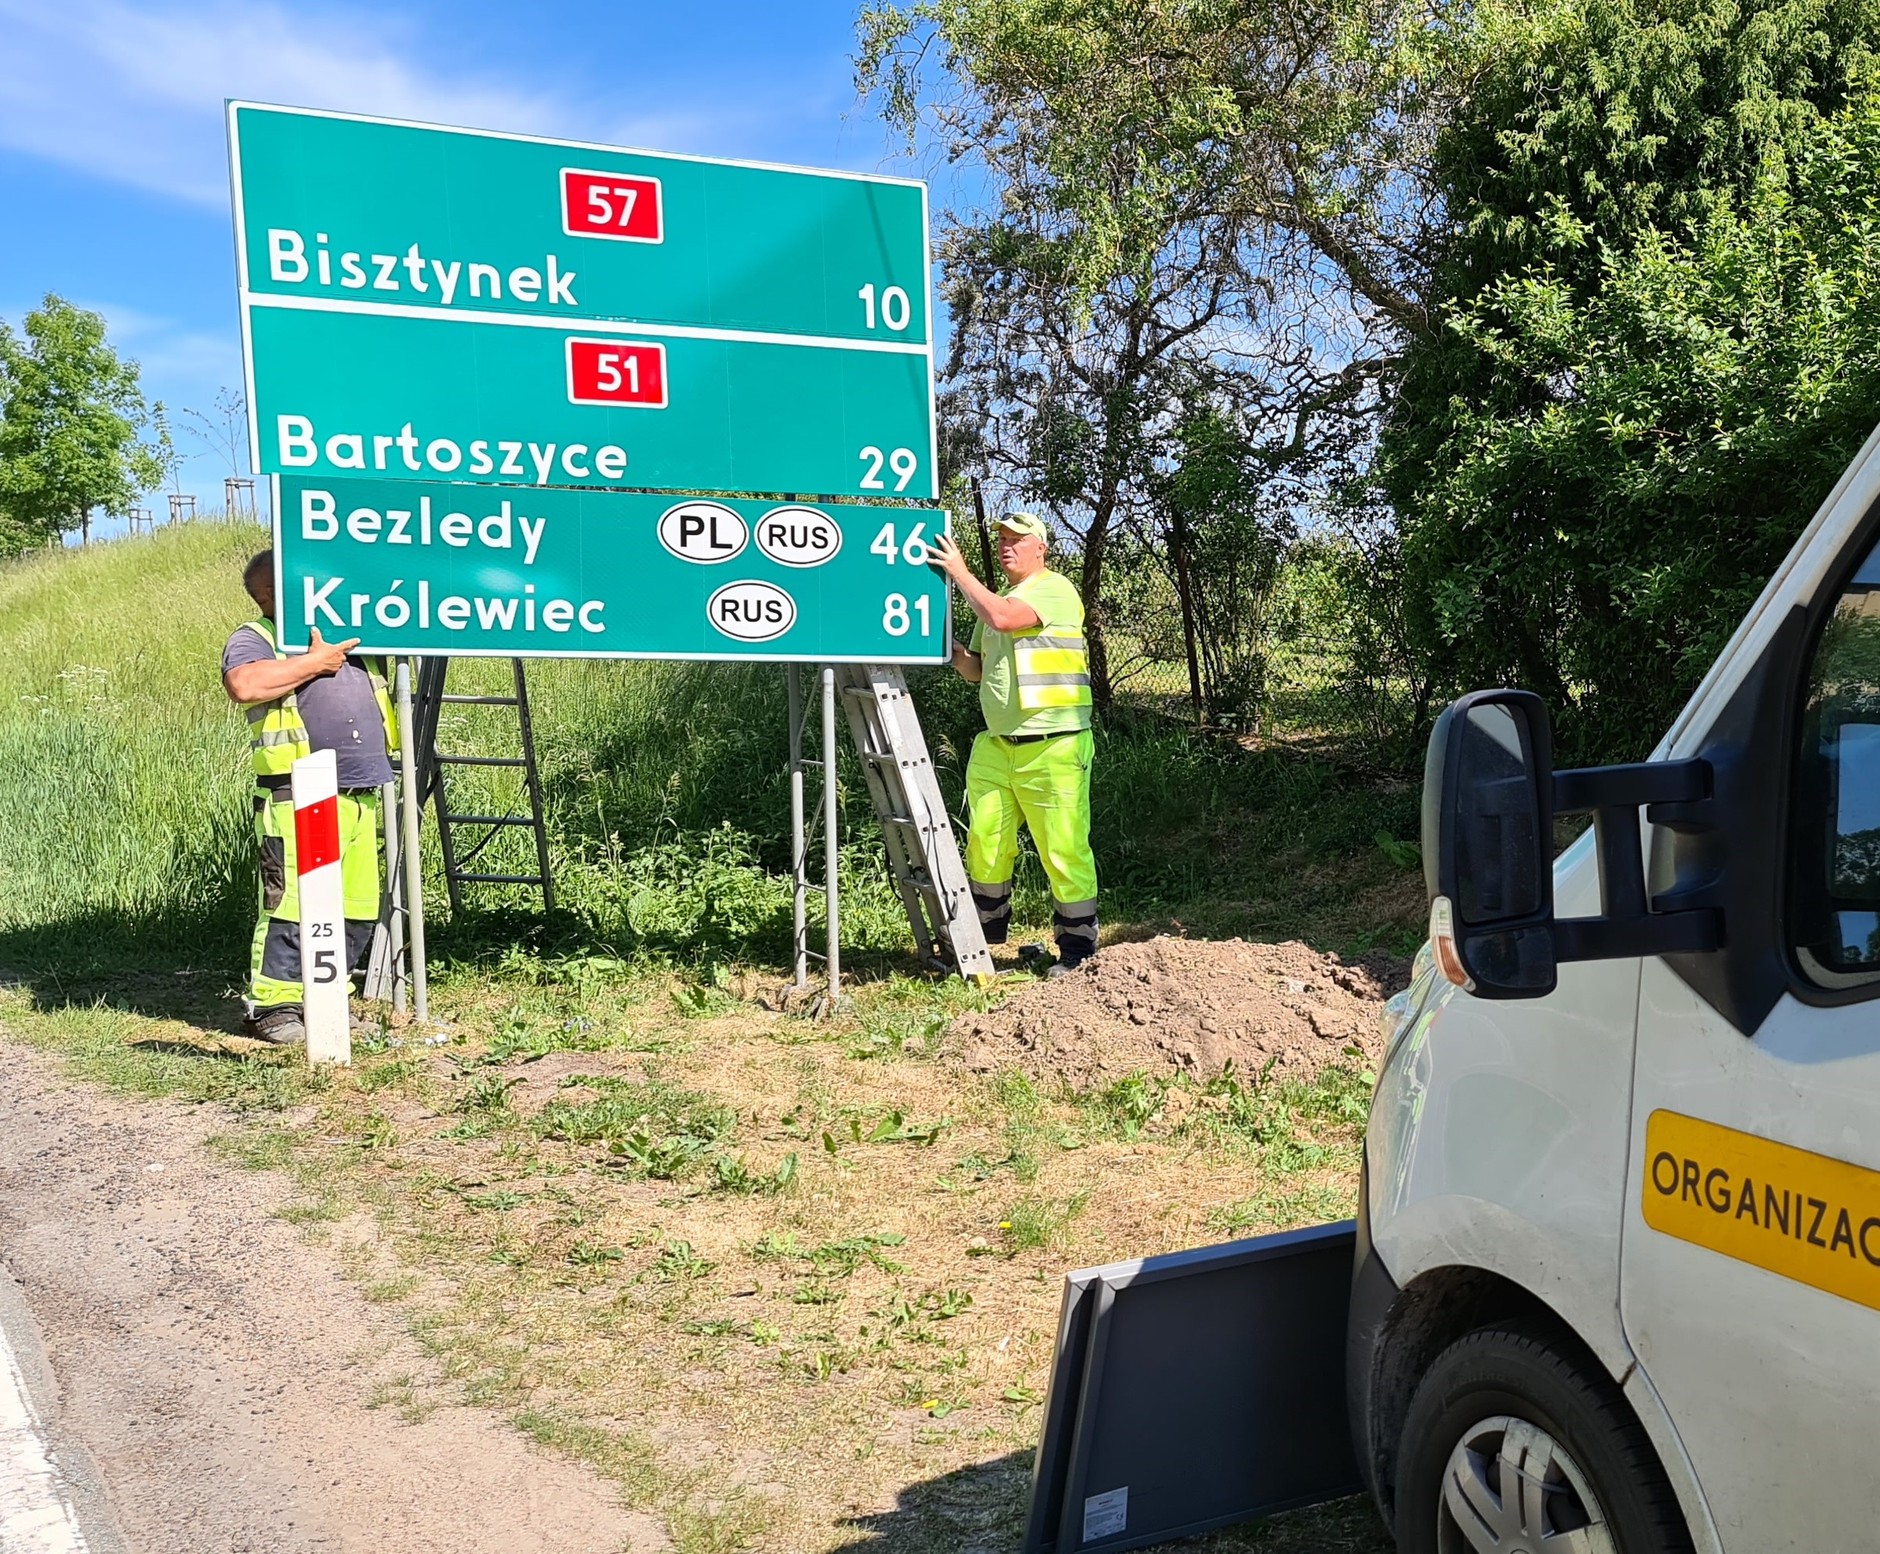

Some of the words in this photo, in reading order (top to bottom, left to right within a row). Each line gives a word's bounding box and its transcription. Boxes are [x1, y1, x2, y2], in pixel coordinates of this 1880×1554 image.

[588, 186, 638, 227] 57
[268, 229, 578, 306] Bisztynek
[858, 284, 910, 331] 10
[597, 354, 639, 393] 51
[277, 414, 628, 485] Bartoszyce
[859, 446, 917, 492] 29
[301, 490, 546, 565] Bezledy
[679, 515, 733, 550] PL
[768, 523, 829, 550] RUS
[870, 522, 929, 566] 46
[303, 576, 606, 633] Królewiec
[721, 598, 783, 623] RUS
[882, 593, 930, 637] 81
[311, 923, 333, 938] 25
[313, 950, 338, 984] 5
[1652, 1151, 1880, 1267] ORGANIZAC
